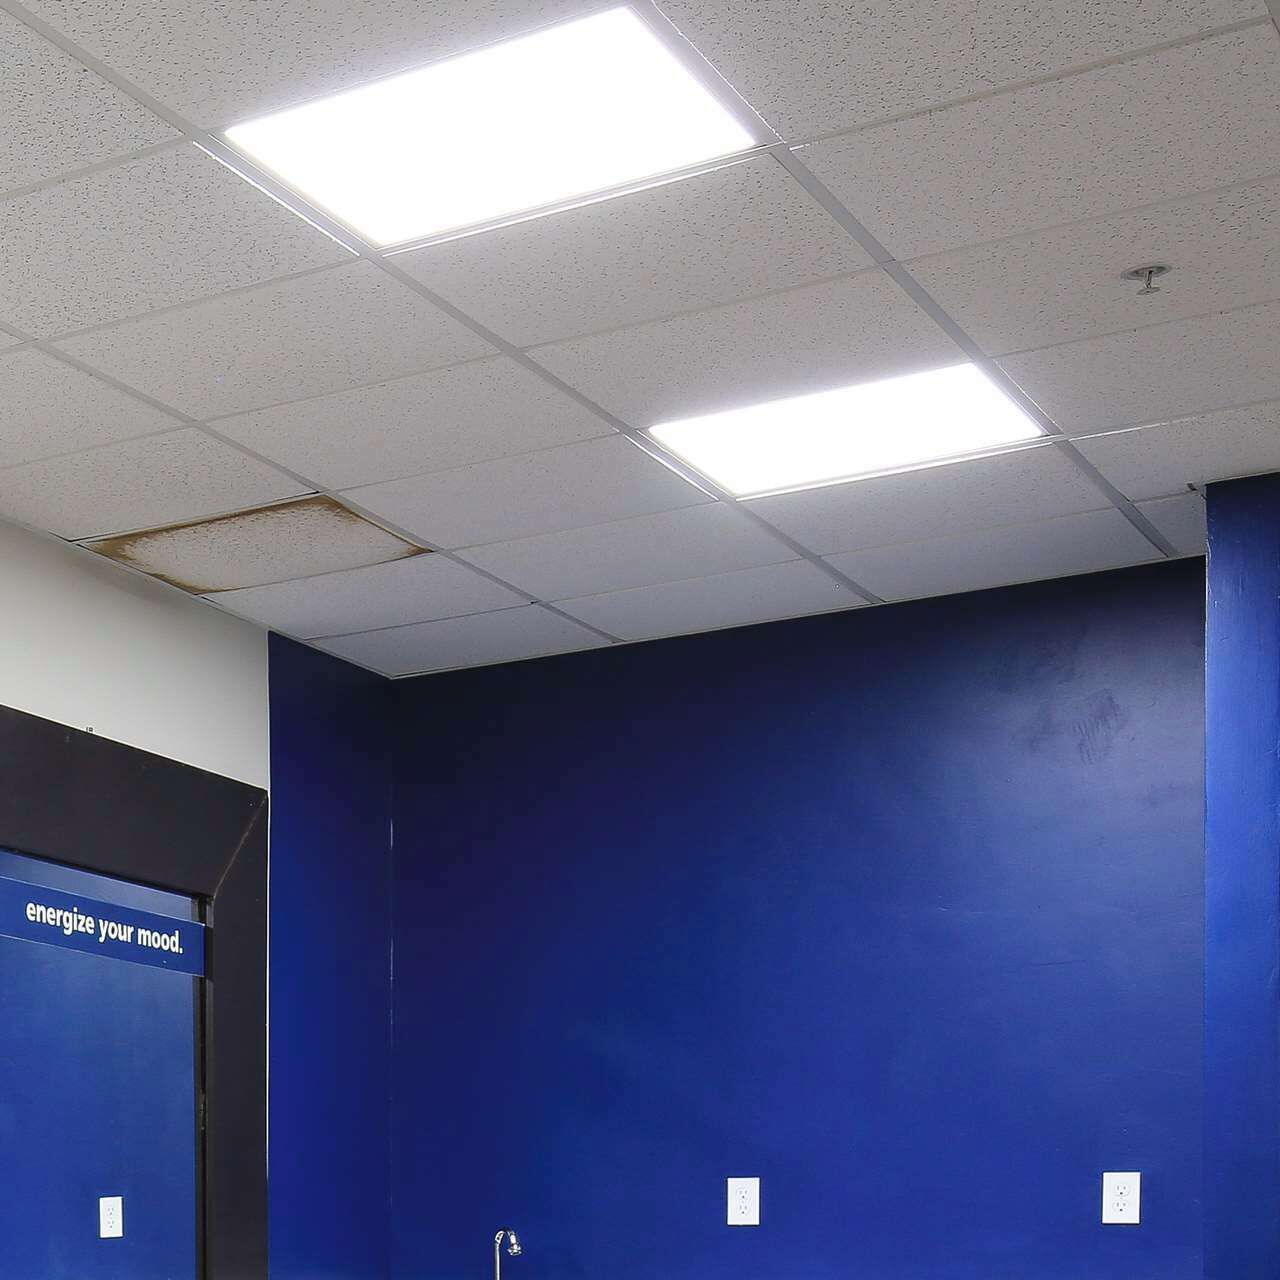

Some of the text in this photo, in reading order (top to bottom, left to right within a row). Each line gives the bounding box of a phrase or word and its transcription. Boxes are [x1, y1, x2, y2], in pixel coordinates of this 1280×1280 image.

[26, 902, 183, 954] energize your mood.
